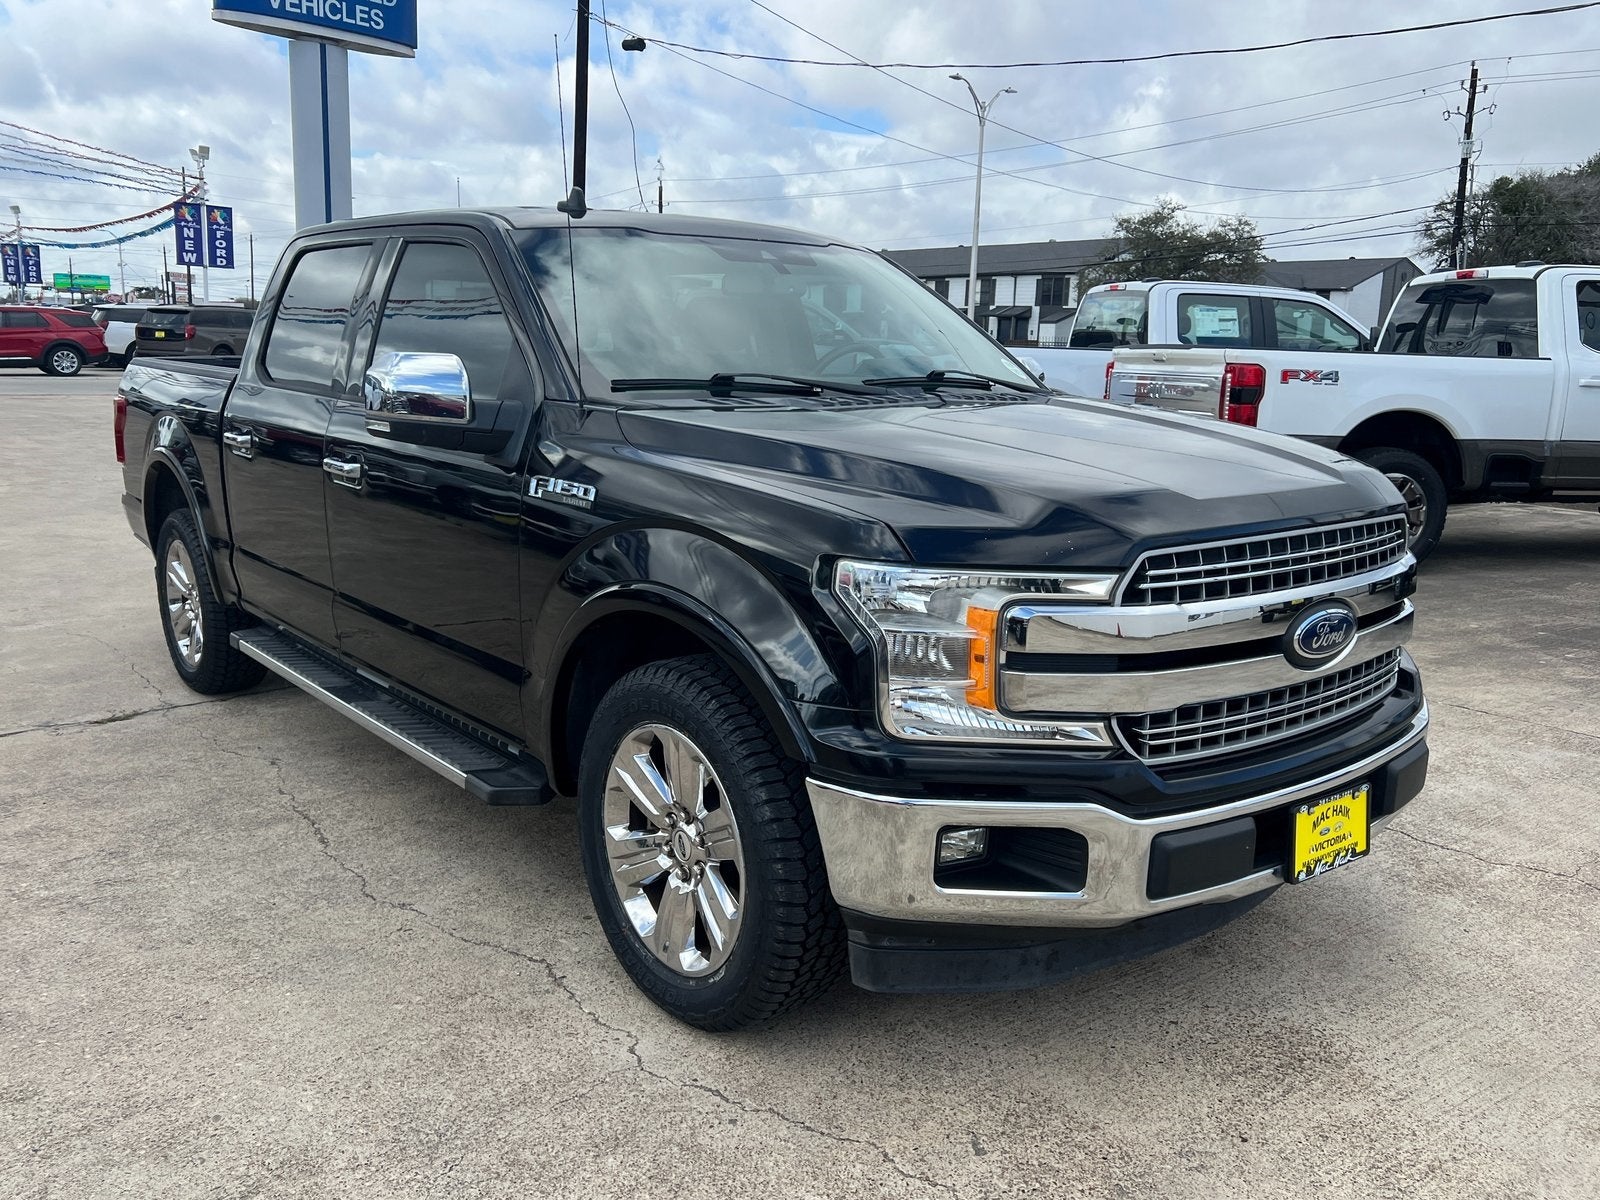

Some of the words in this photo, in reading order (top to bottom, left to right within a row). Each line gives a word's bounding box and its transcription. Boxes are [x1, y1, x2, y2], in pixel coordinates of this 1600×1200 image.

[183, 227, 197, 263] NEW
[215, 230, 227, 266] FORD
[6, 259, 17, 281] NEW
[28, 260, 37, 282] FORD
[1280, 369, 1339, 384] FX4
[1312, 619, 1347, 649] Ford
[1312, 807, 1331, 833] MAC
[1332, 804, 1351, 820] HAIK
